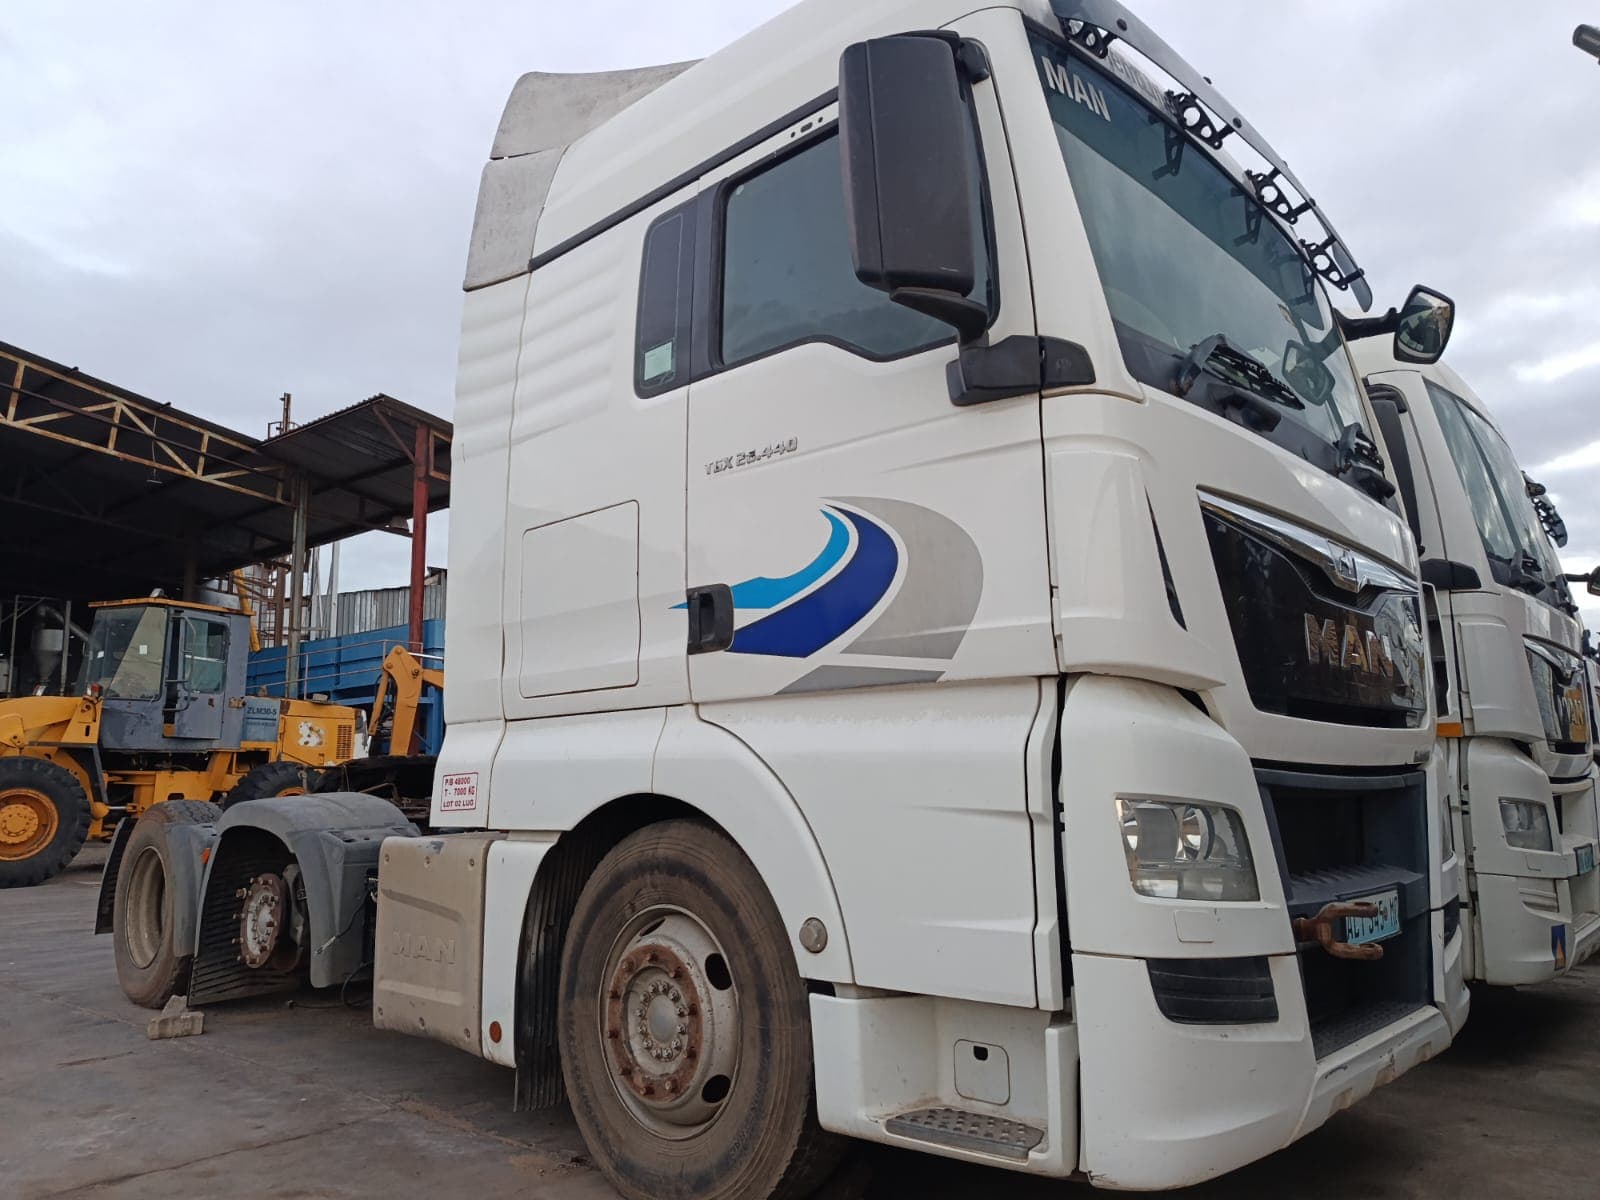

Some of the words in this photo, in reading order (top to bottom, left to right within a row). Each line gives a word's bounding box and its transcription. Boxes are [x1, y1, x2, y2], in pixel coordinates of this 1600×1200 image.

[1041, 55, 1111, 122] MAN
[704, 455, 734, 475] TGX
[1304, 612, 1394, 679] MAN
[443, 800, 453, 808] LOT
[392, 930, 456, 966] MAN
